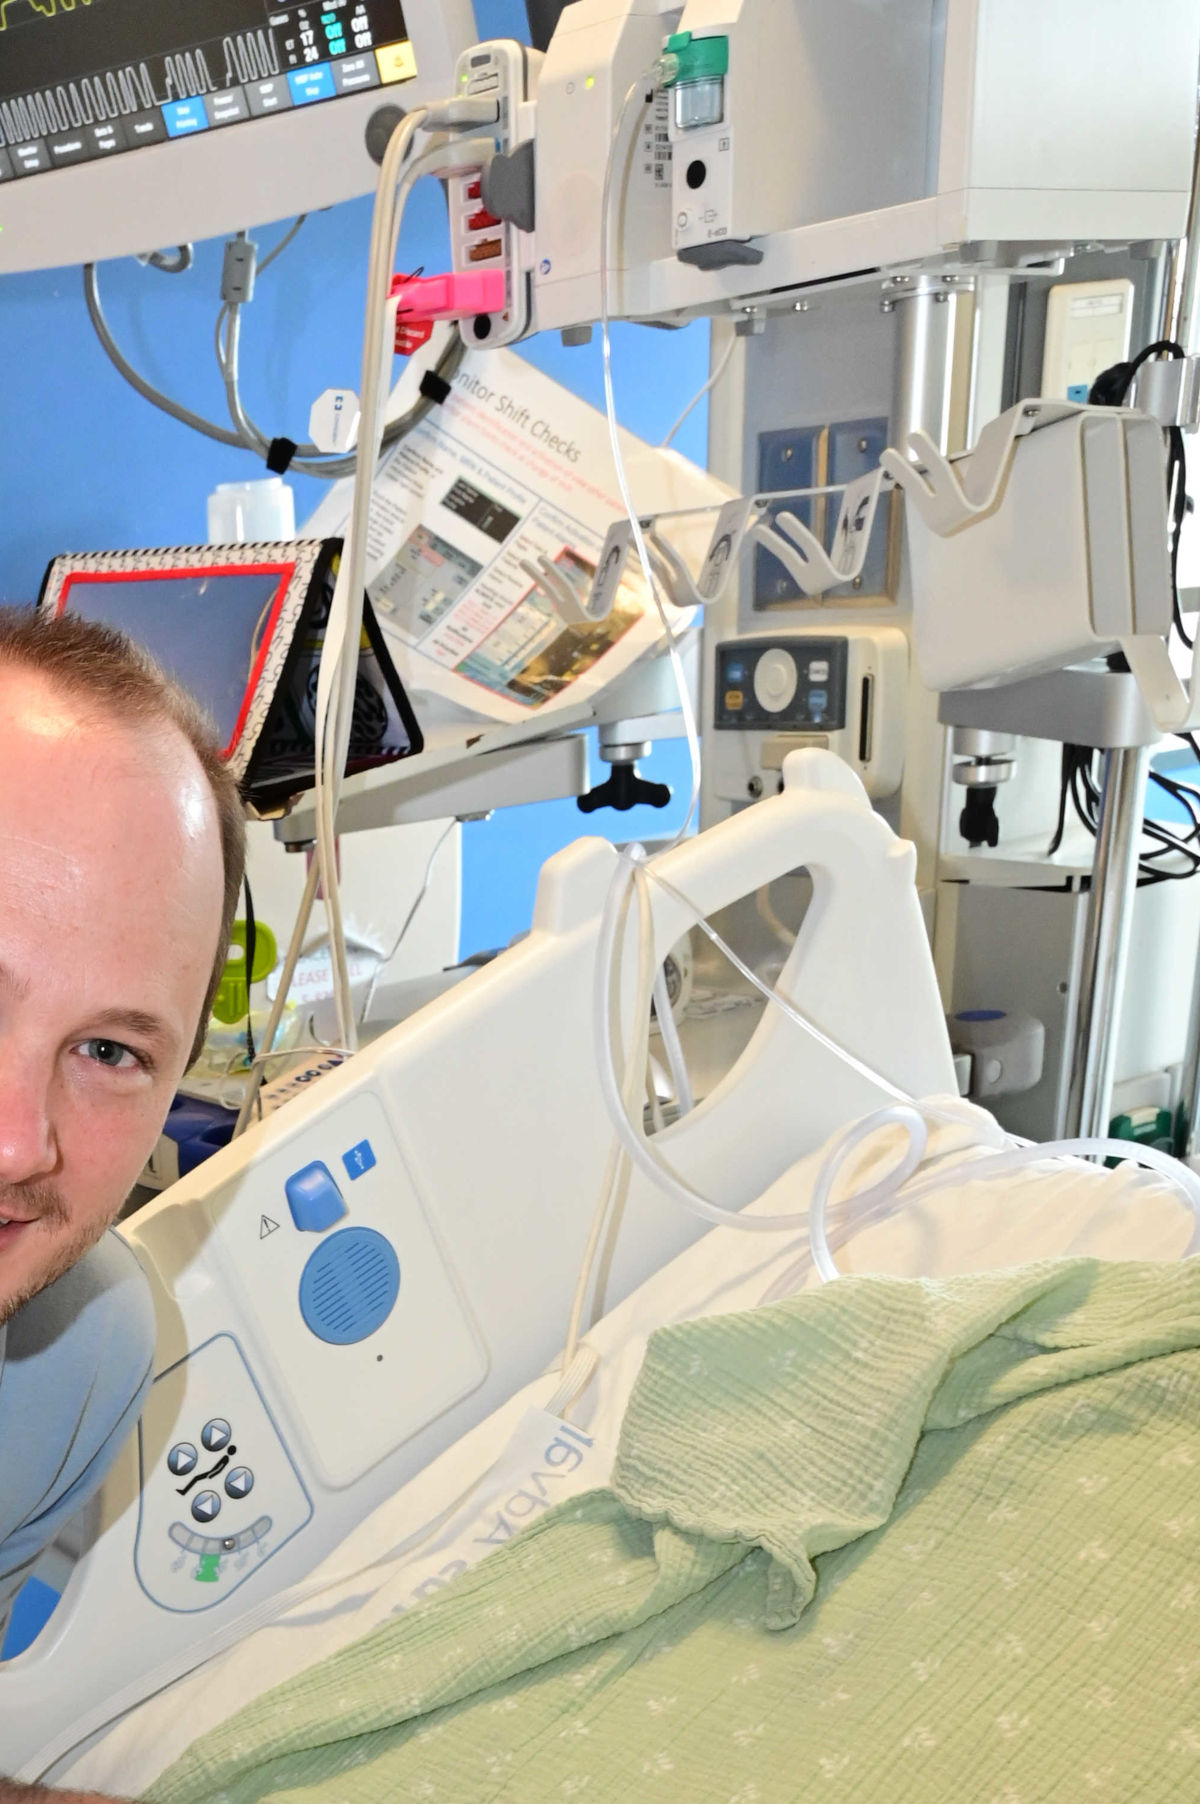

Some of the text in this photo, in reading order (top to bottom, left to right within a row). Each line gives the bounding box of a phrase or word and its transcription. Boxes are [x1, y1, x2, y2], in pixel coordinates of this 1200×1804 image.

[300, 30, 314, 46] 17
[325, 22, 343, 39] Off
[351, 15, 368, 32] Off
[303, 46, 319, 62] 24
[329, 38, 346, 55] Off
[354, 31, 372, 48] Off
[455, 371, 495, 404] nitor
[494, 395, 531, 429] Shift
[529, 420, 581, 463] Checks
